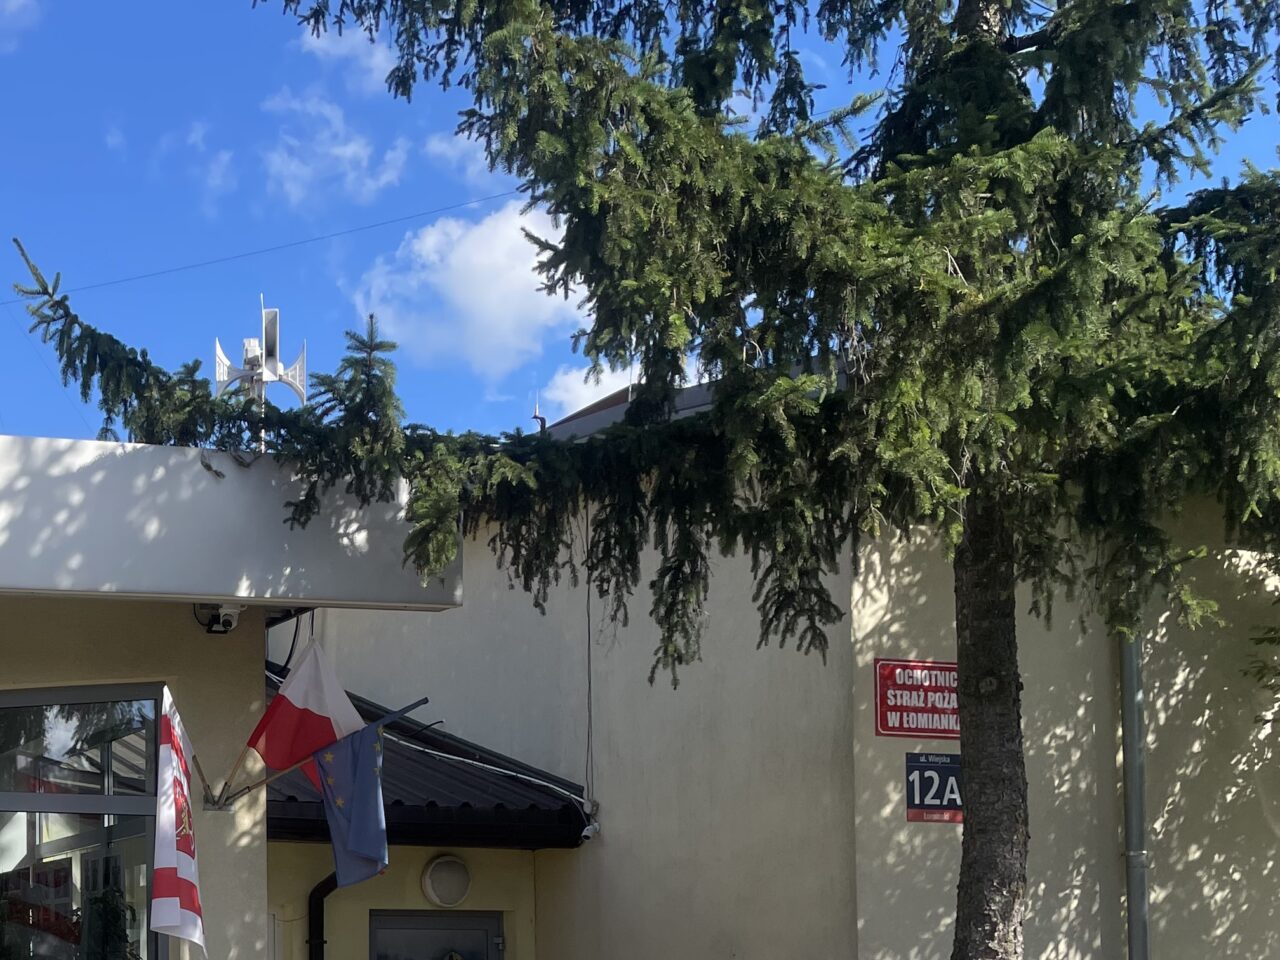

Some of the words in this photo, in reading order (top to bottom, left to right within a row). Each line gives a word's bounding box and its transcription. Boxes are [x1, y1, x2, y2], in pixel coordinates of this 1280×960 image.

[895, 668, 958, 687] OCHOTNIC
[887, 688, 925, 707] STRAŻ
[927, 690, 958, 709] POŻA
[887, 711, 900, 728] W
[903, 712, 960, 731] ŁOMIANK
[908, 770, 963, 806] 12A
